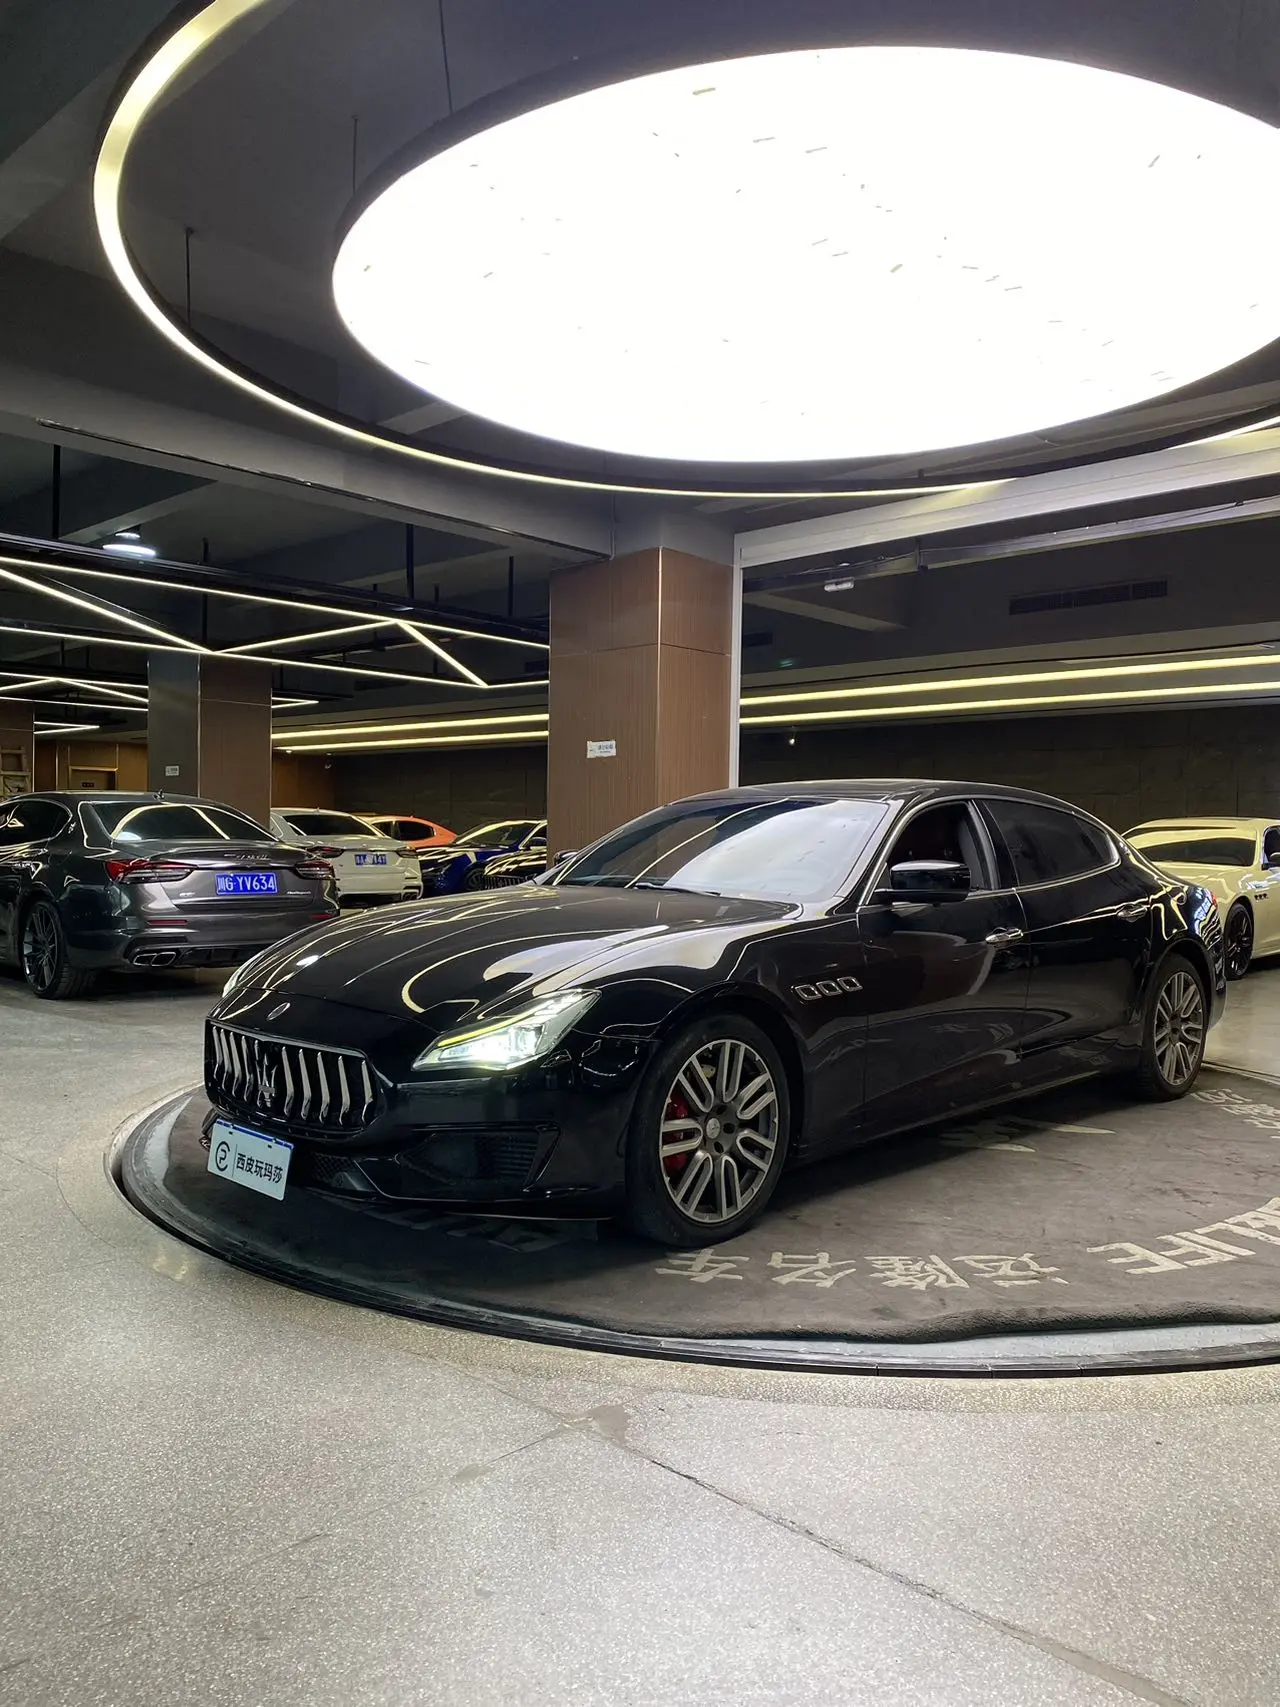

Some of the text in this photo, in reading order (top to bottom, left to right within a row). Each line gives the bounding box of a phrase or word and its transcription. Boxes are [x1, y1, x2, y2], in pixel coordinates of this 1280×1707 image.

[236, 1152, 283, 1184] 西皮玩玛莎
[655, 1248, 1070, 1291] 运隆名车
